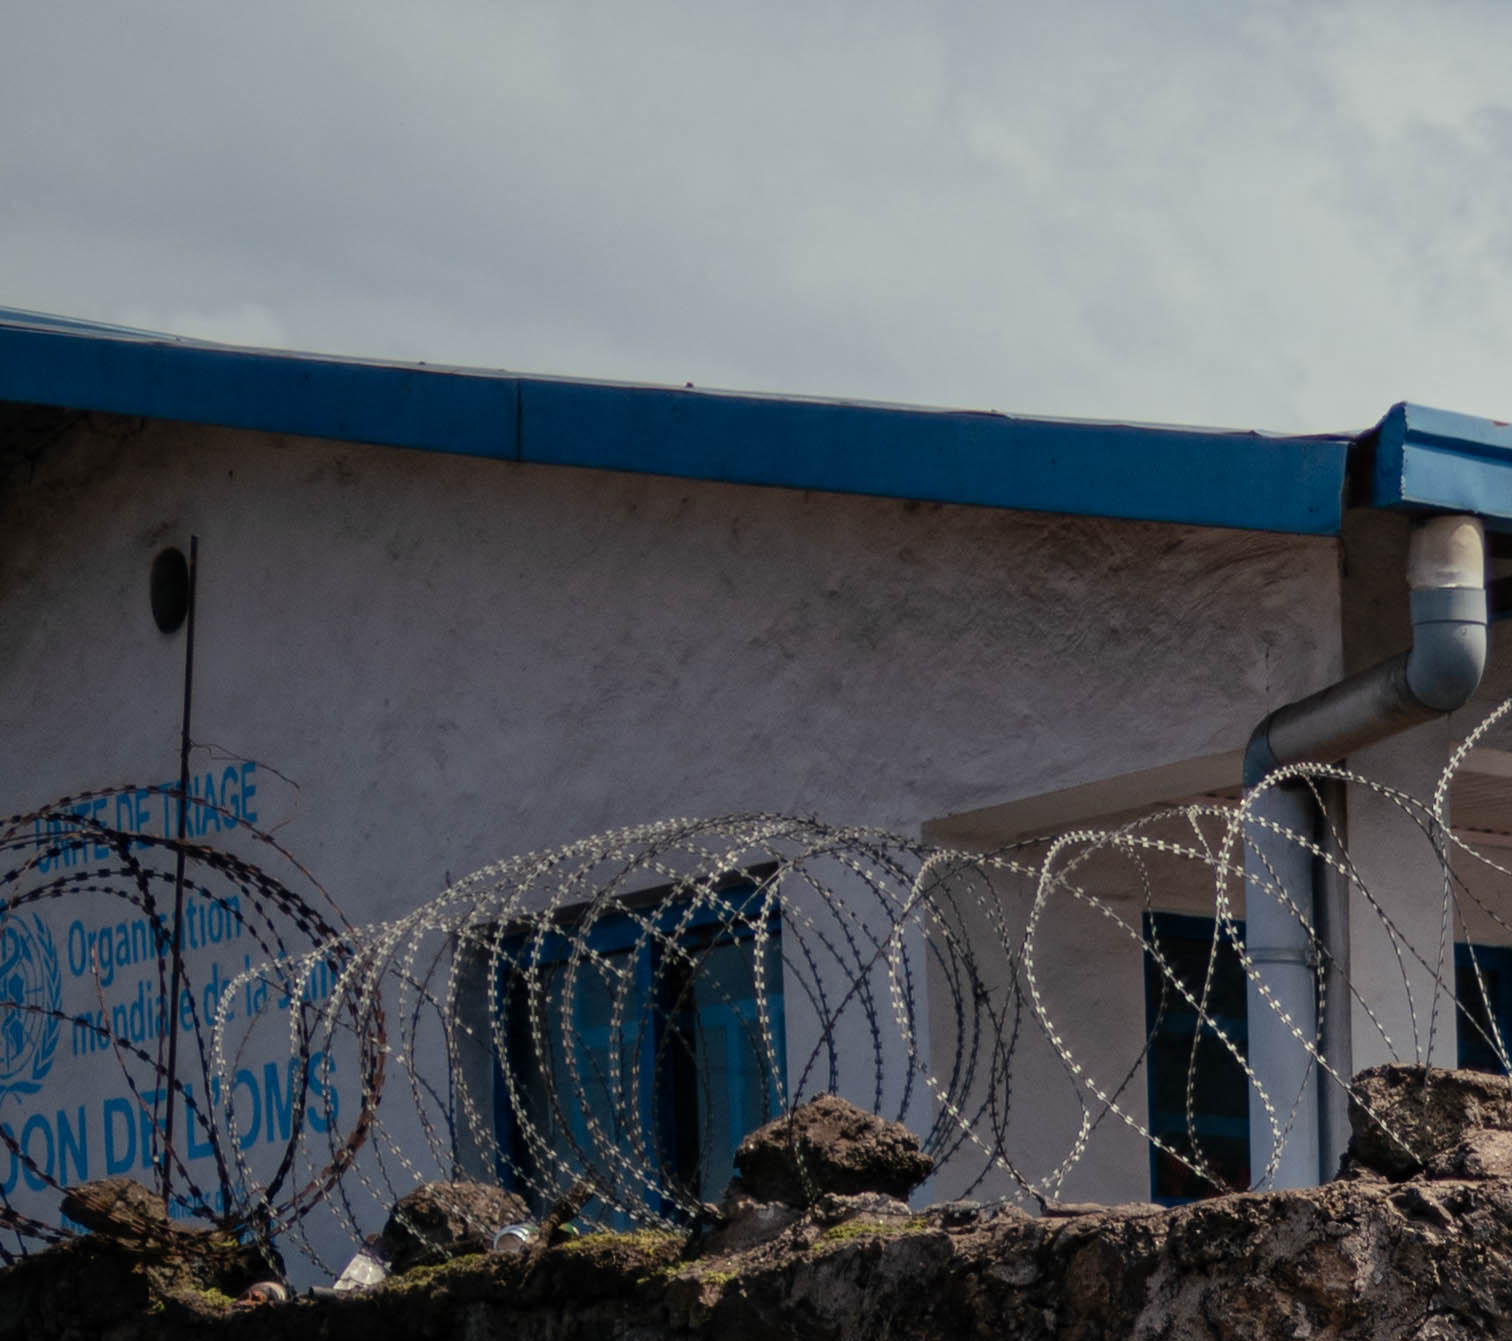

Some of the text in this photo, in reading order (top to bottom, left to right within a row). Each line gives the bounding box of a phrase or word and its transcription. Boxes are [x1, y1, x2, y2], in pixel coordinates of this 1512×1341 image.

[160, 762, 258, 839] TRIAGE
[73, 974, 195, 1057] mondiae
[104, 1088, 168, 1175] DE
